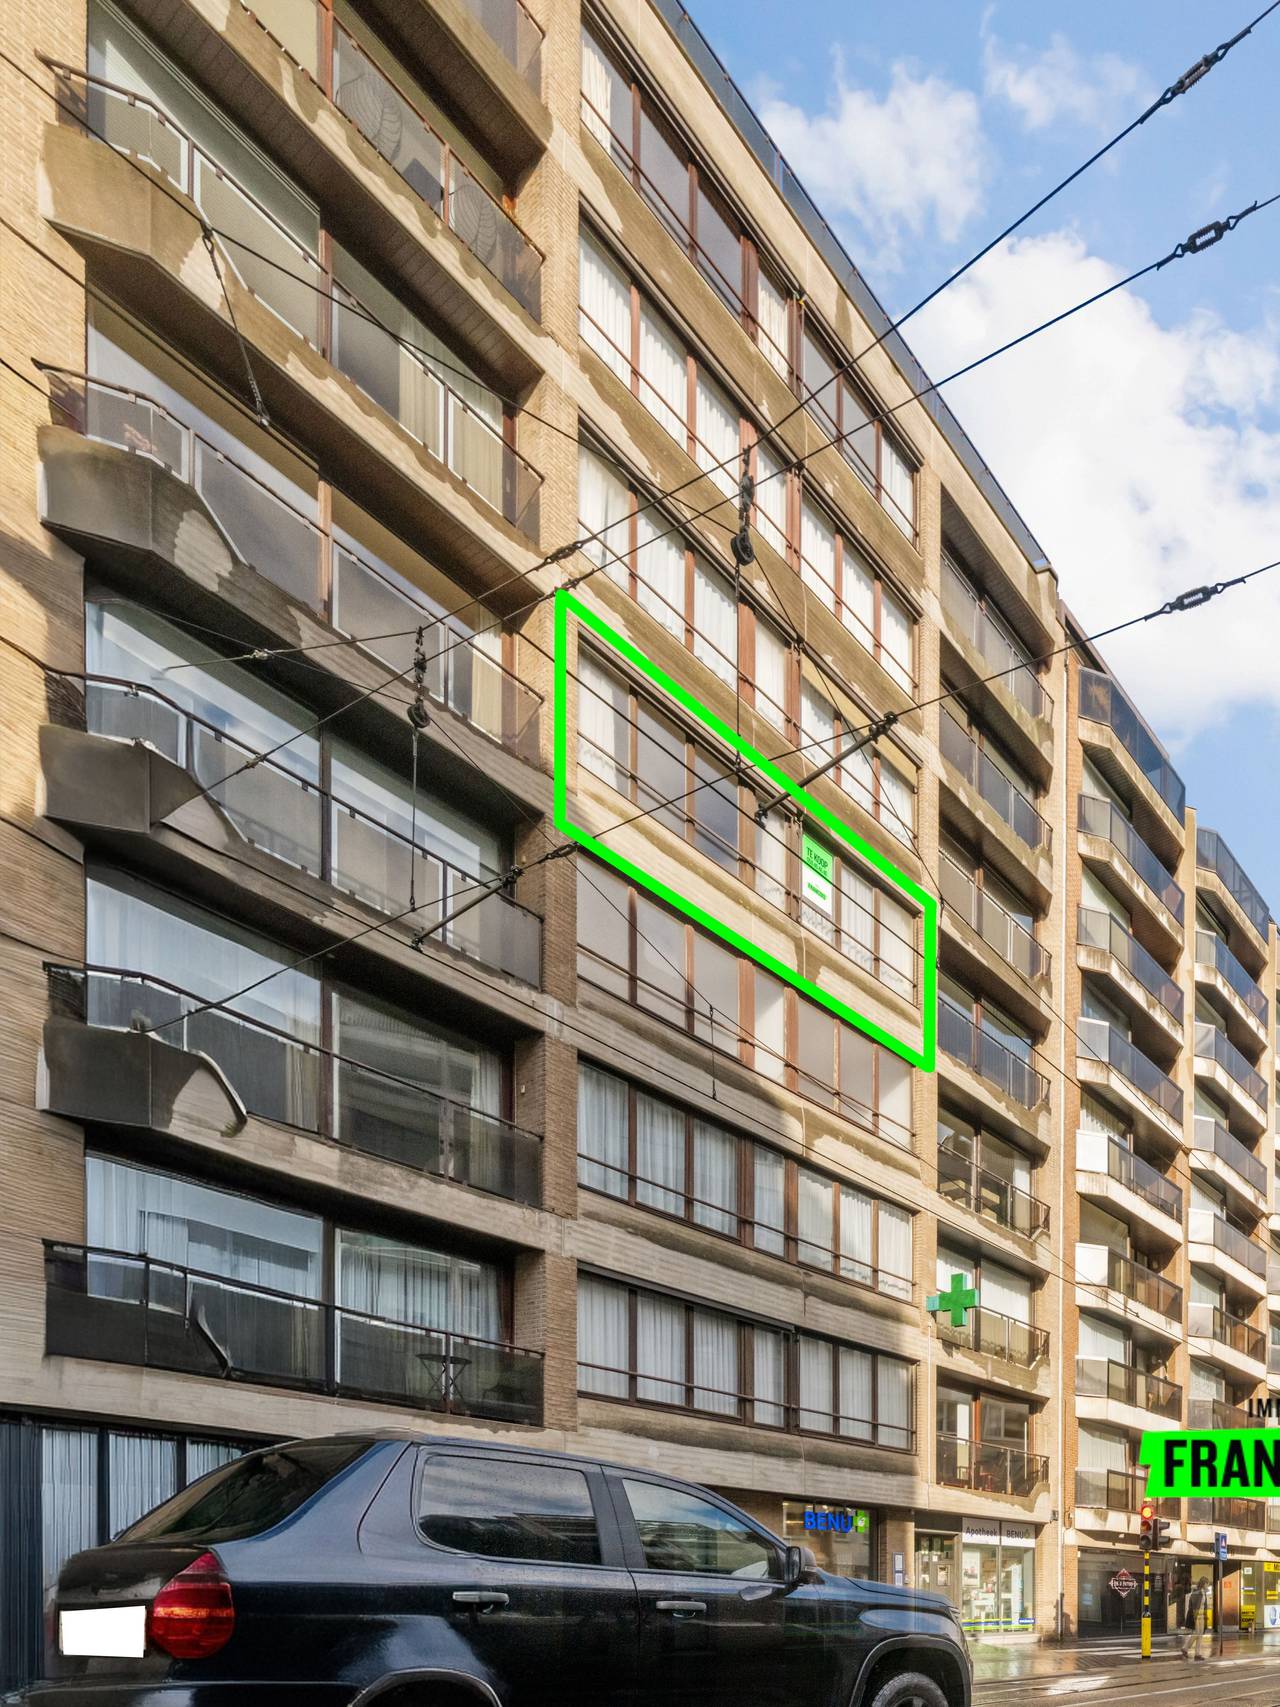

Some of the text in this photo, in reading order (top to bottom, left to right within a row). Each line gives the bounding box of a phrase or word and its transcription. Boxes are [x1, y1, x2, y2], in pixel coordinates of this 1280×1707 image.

[806, 847, 813, 858] TE
[814, 852, 829, 868] KOOP
[804, 1511, 852, 1533] BENU
[965, 1526, 998, 1537] Apotheek
[1006, 1530, 1024, 1539] BENU
